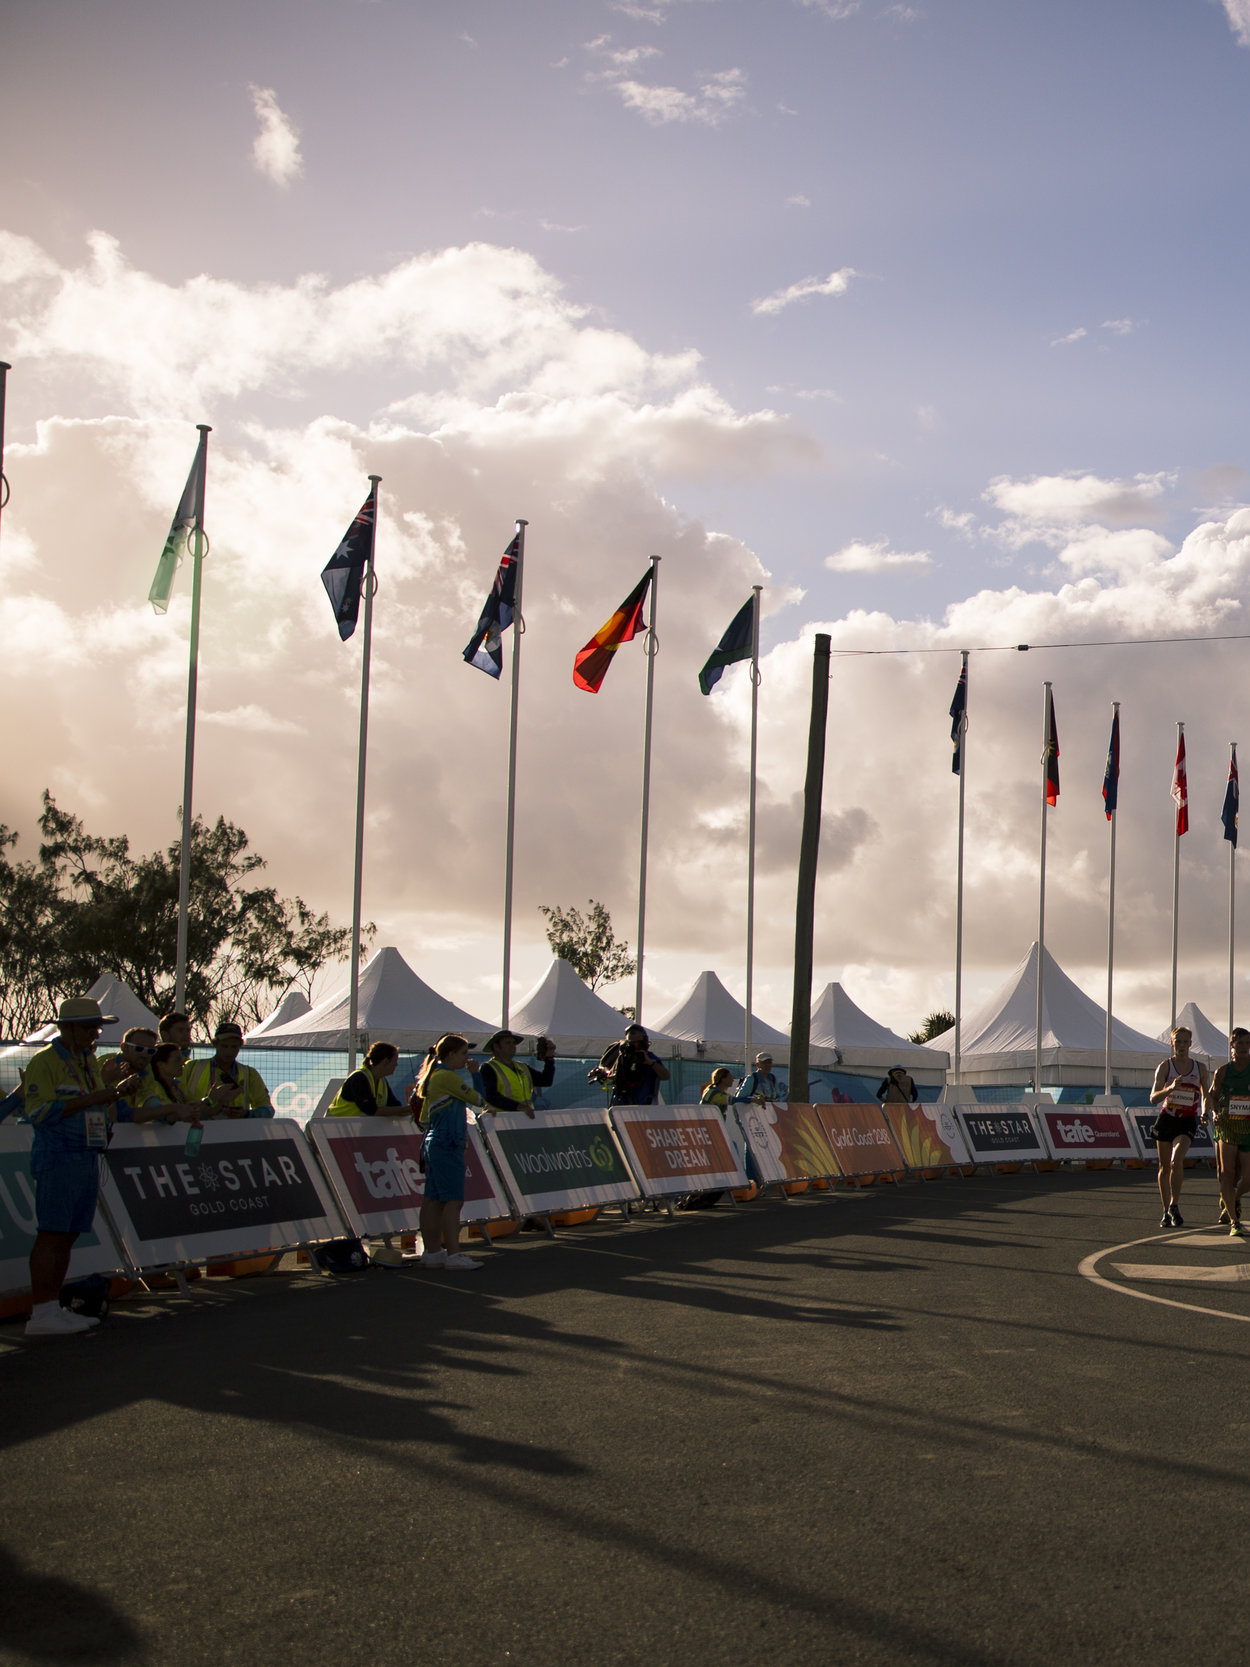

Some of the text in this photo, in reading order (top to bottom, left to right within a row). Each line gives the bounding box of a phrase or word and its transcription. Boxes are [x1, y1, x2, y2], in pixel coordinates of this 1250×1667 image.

[645, 1127, 713, 1149] SHARE THE
[830, 1127, 851, 1150] Gold
[852, 1127, 875, 1147] Coast
[969, 1120, 995, 1136] THE
[1001, 1119, 1032, 1135] STAR
[1056, 1119, 1095, 1143] tafe
[664, 1148, 711, 1169] DREAM
[123, 1155, 302, 1200] THE STAR
[353, 1146, 426, 1200] tafe
[188, 1195, 270, 1216] GOLD COAST
